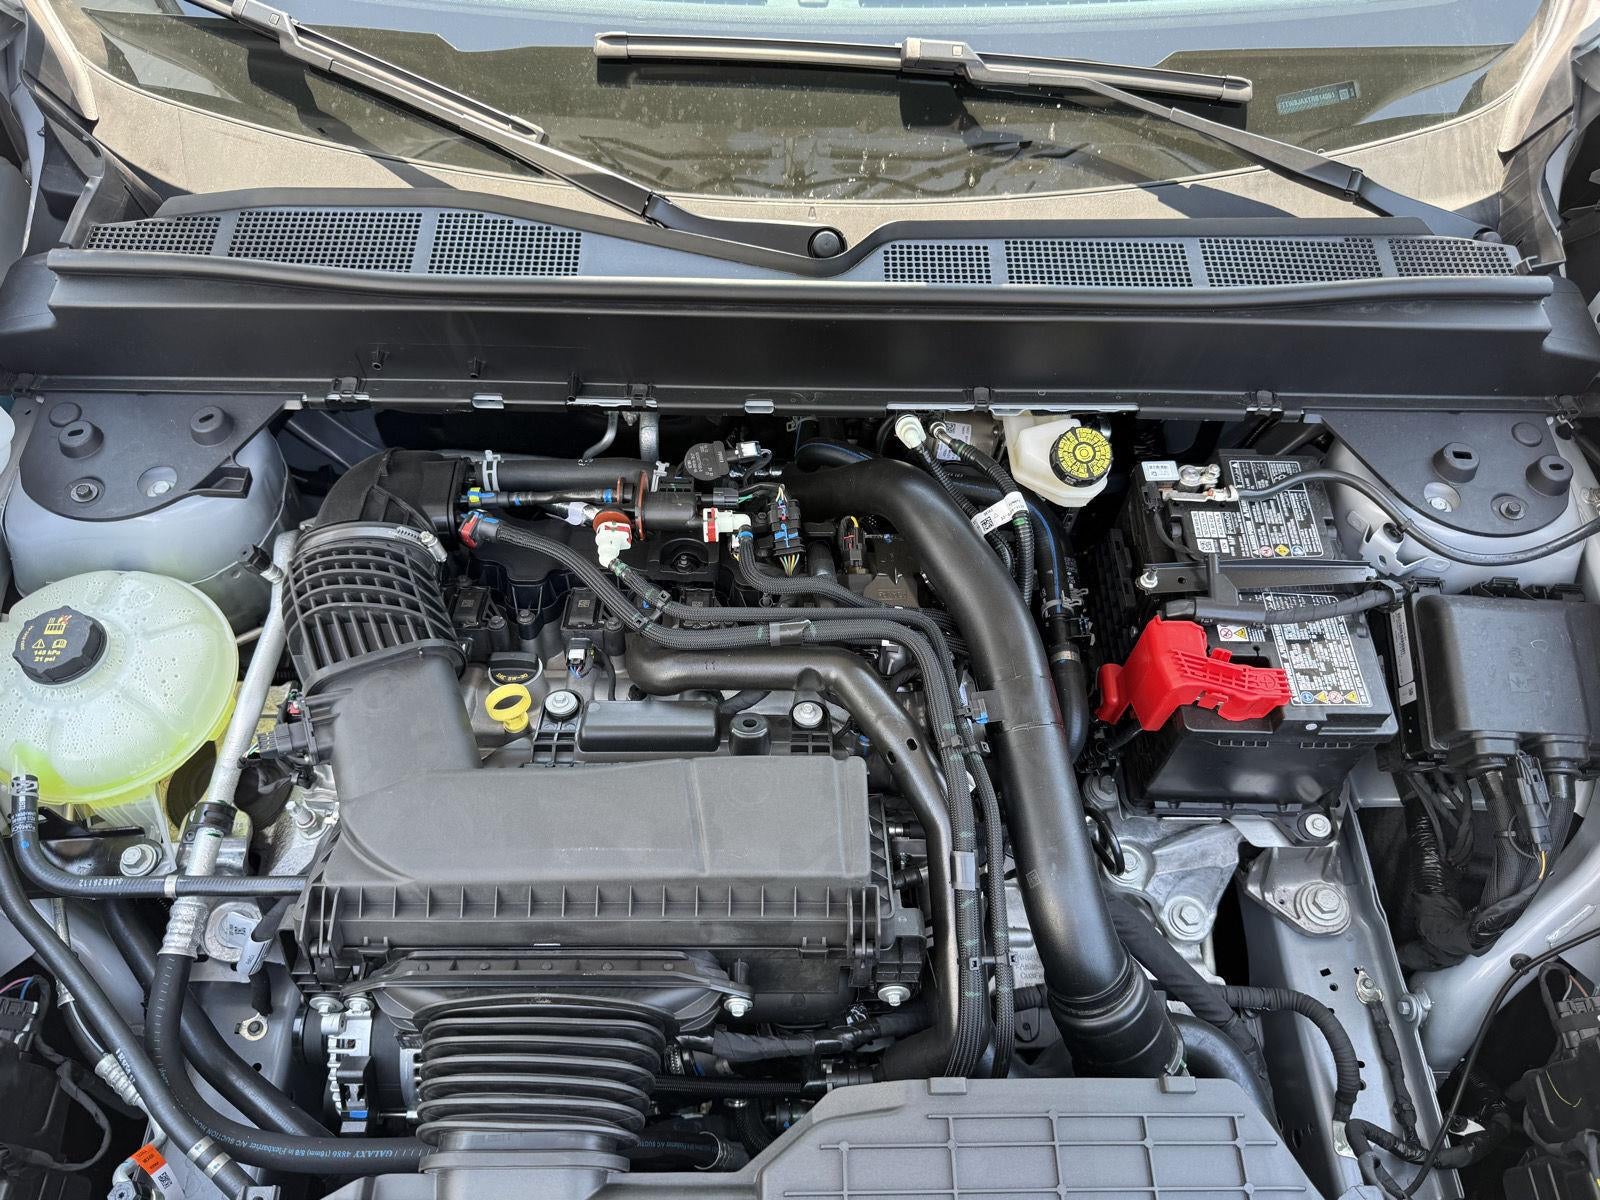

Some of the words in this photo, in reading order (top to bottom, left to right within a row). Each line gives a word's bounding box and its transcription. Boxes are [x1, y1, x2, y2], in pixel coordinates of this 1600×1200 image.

[207, 1129, 234, 1145] SUCTION
[236, 1140, 248, 1148] A/C
[249, 1143, 288, 1155] Flexbarrier
[306, 1149, 331, 1158] (16mm)
[353, 1149, 393, 1158] GALAXY
[332, 1150, 352, 1158] 4886
